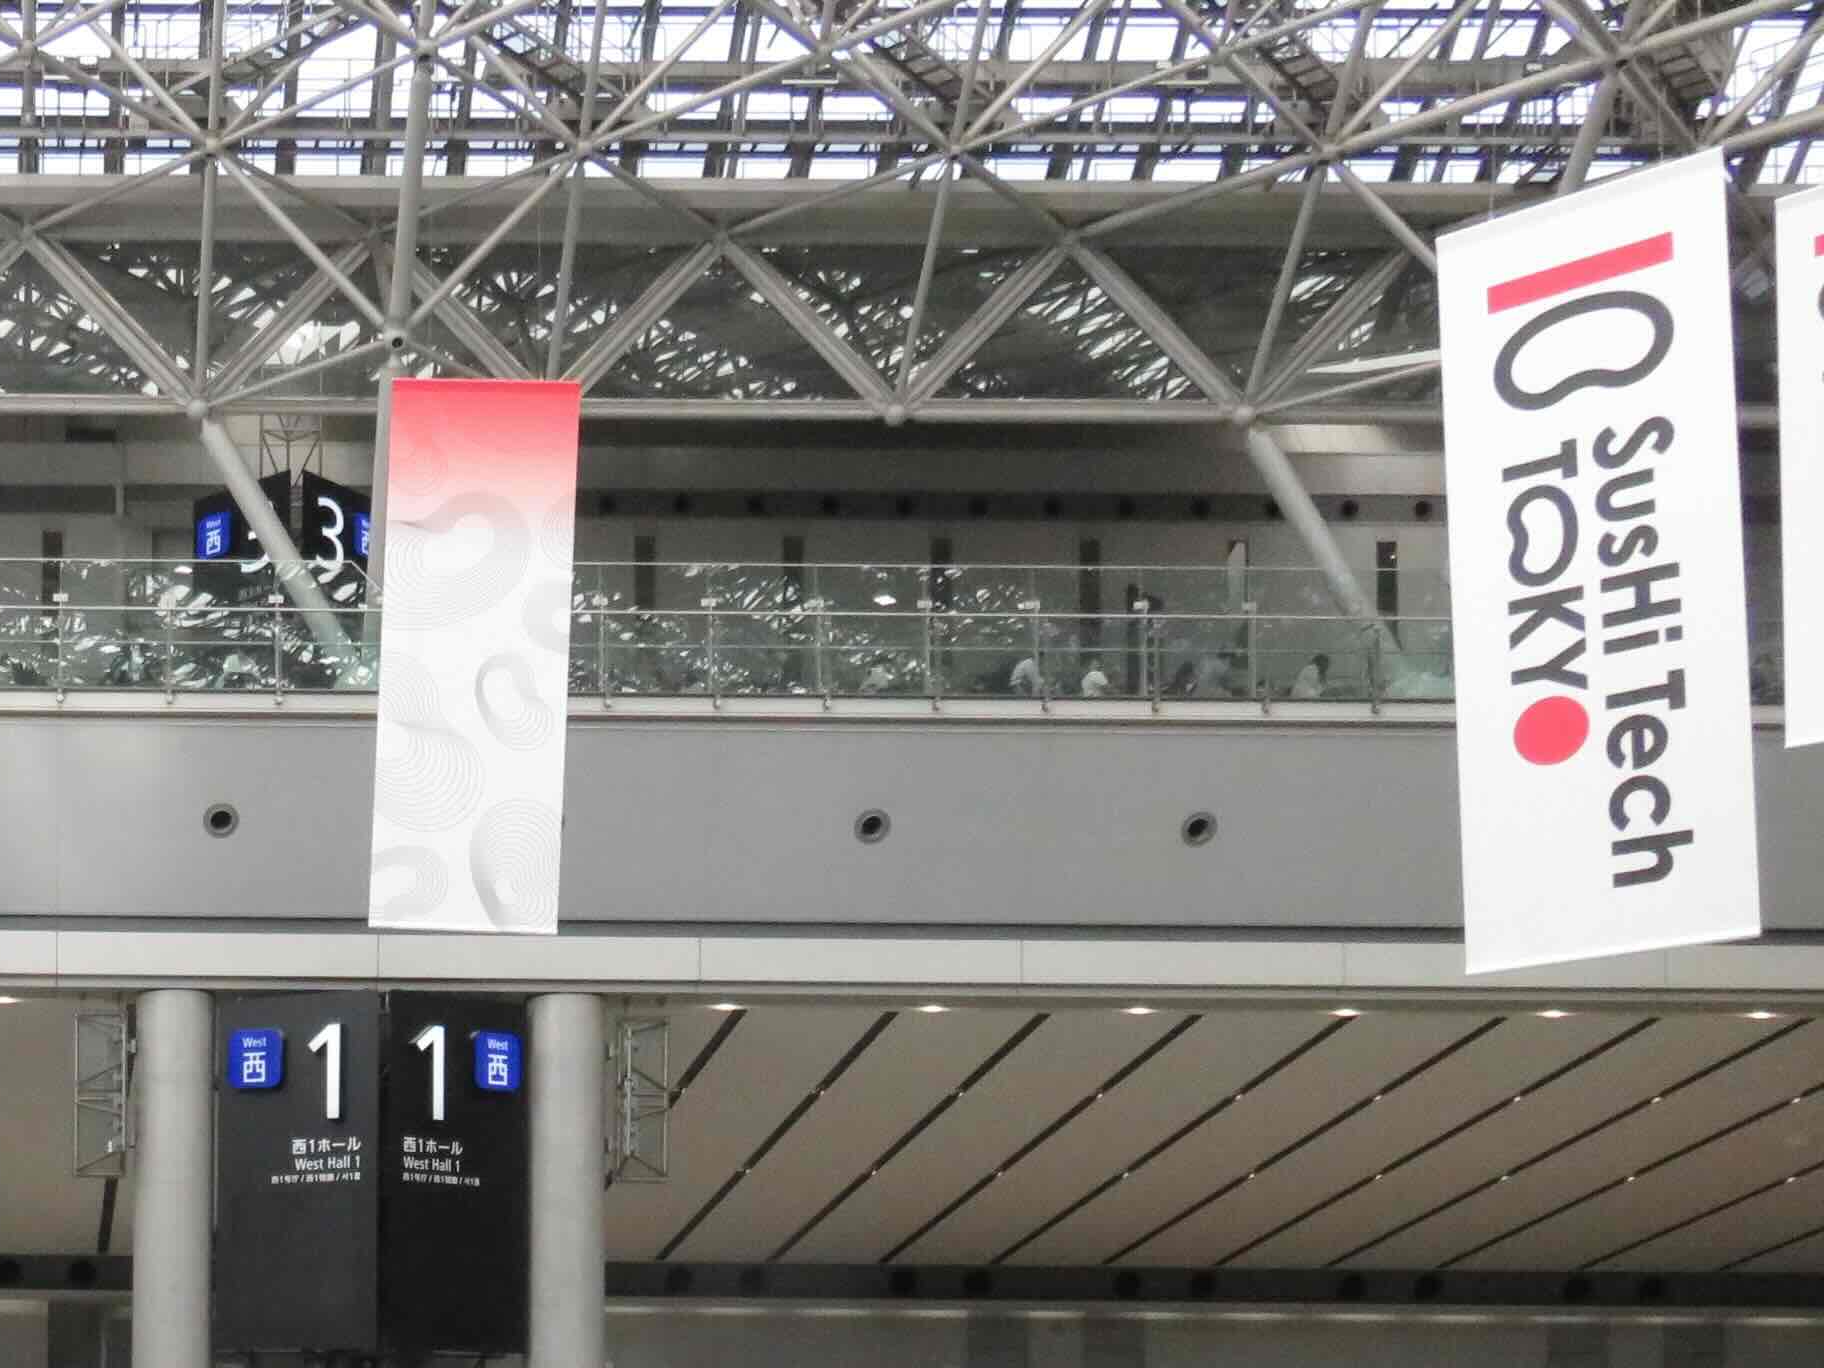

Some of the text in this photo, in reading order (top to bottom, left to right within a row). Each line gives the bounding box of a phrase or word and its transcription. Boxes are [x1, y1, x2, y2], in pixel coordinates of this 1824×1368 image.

[317, 497, 344, 584] 3
[1605, 668, 1694, 888] Tech
[242, 1036, 267, 1048] West
[487, 1039, 509, 1051] West
[243, 1052, 266, 1083] 西
[307, 1023, 341, 1119] 1
[416, 1025, 446, 1121] 1
[488, 1054, 508, 1086] 西
[292, 1136, 361, 1155] 西1ホール
[403, 1136, 463, 1156] 西1ホール
[295, 1155, 360, 1171] West Hall 1
[403, 1156, 460, 1172] West Hall 1
